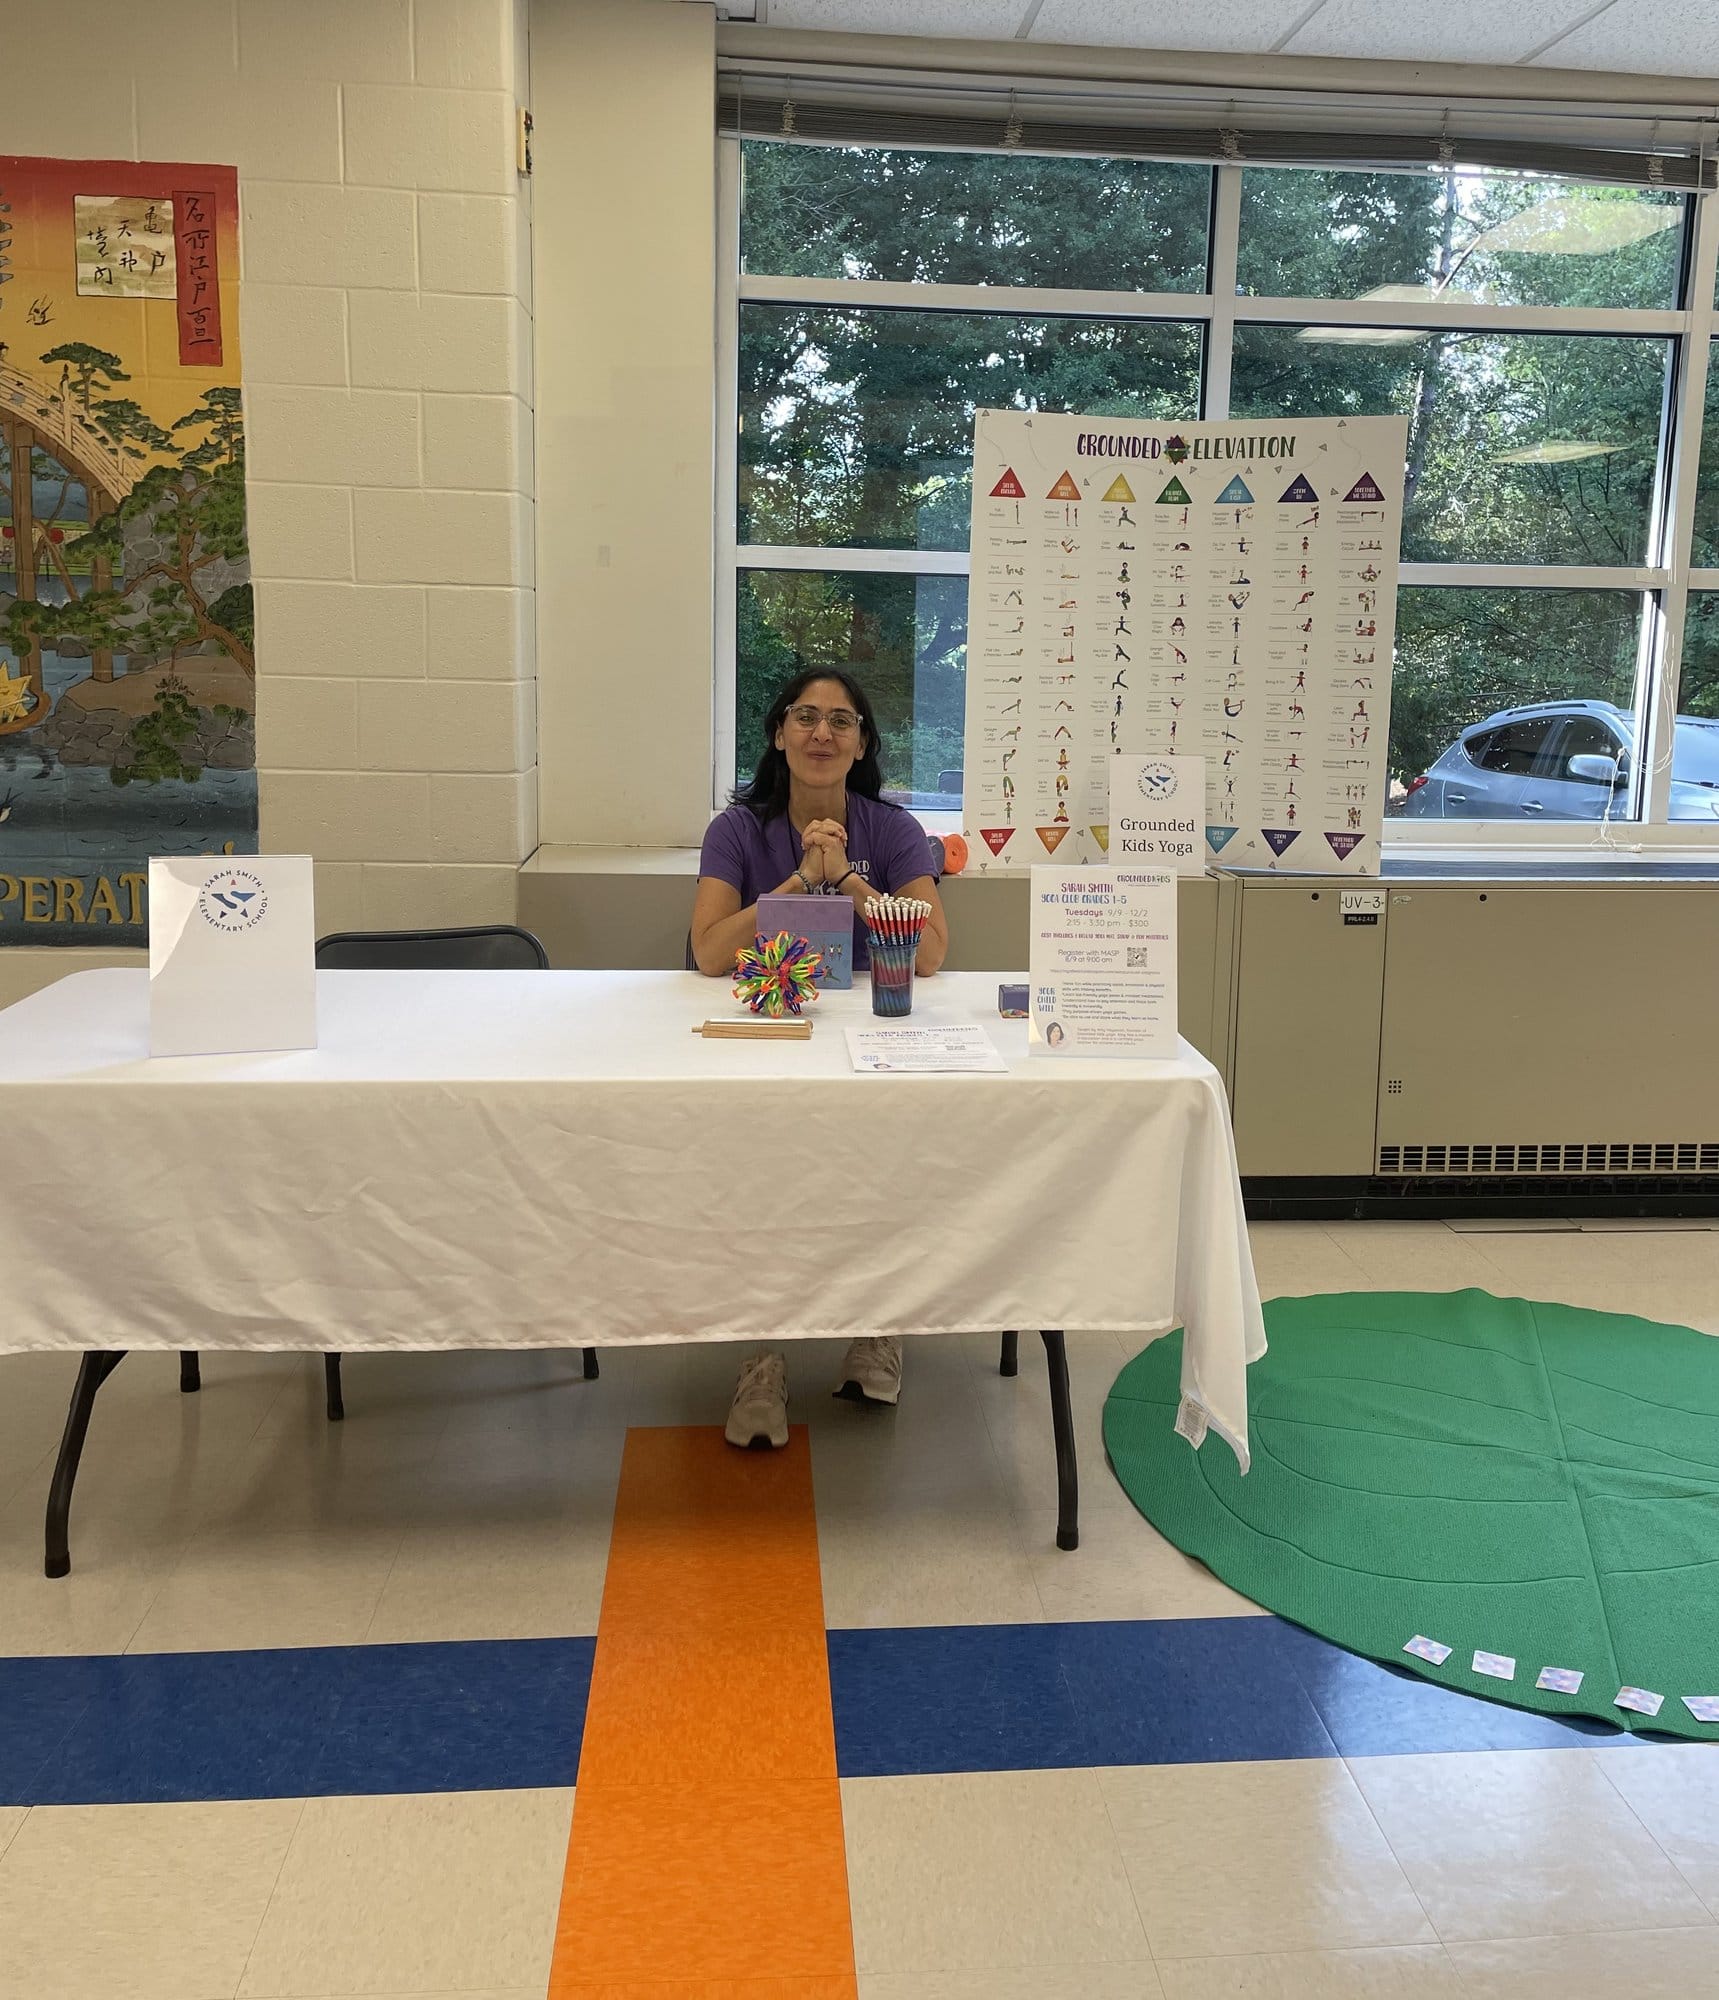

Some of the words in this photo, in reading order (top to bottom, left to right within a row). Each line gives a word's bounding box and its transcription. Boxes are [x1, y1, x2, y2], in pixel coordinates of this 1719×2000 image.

[1077, 434, 1161, 460] GROUNDED
[1193, 436, 1296, 460] ELEVATION
[1141, 762, 1157, 773] SARAH
[1160, 763, 1175, 774] SMITH
[1138, 779, 1163, 801] ELEMENTARY
[1165, 780, 1178, 800] SCHOOL
[1120, 818, 1195, 832] Grounded
[1122, 840, 1154, 852] Kids
[1158, 840, 1193, 856] Yoga
[205, 870, 232, 888] SARAH
[236, 870, 262, 887] SMITH
[1061, 883, 1086, 892] SARAH
[1088, 883, 1113, 893] SMITH
[1113, 896, 1127, 904] 1-5
[1345, 896, 1380, 908] UV-3
[199, 899, 243, 932] ELEMENTARY
[247, 896, 268, 928] SCHOOL
[1065, 909, 1103, 917] Tuesdays
[1108, 909, 1122, 917] 9/9
[1129, 920, 1149, 928] $300
